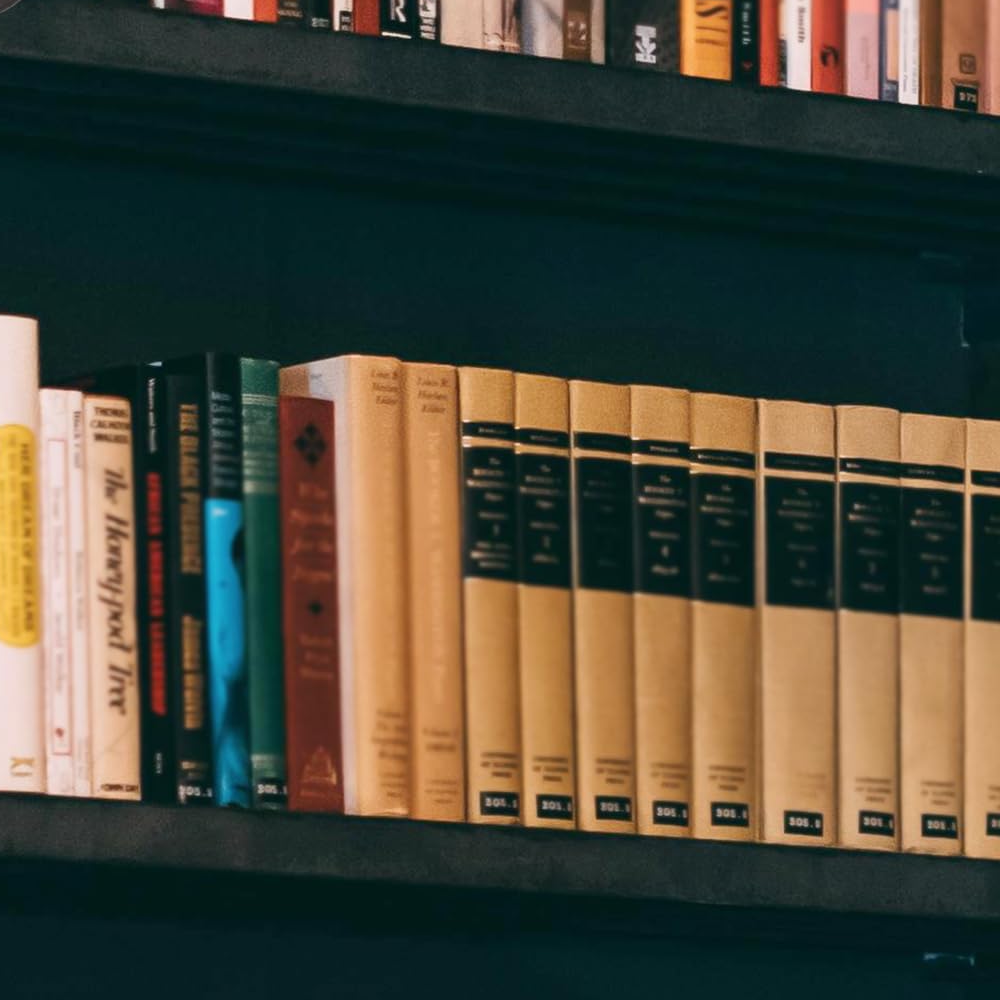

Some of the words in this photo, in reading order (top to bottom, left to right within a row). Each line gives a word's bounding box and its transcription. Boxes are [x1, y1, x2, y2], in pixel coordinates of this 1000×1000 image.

[742, 3, 754, 46] Smith
[797, 7, 808, 43] Smith
[179, 403, 201, 432] THE
[20, 442, 35, 468] HER
[179, 434, 201, 487] BLACK
[20, 474, 35, 539] DREAM
[102, 467, 129, 504] The
[20, 543, 35, 561] OF
[20, 564, 35, 632] DREAMS
[96, 513, 132, 650] Honey-pod
[106, 662, 135, 716] Tree
